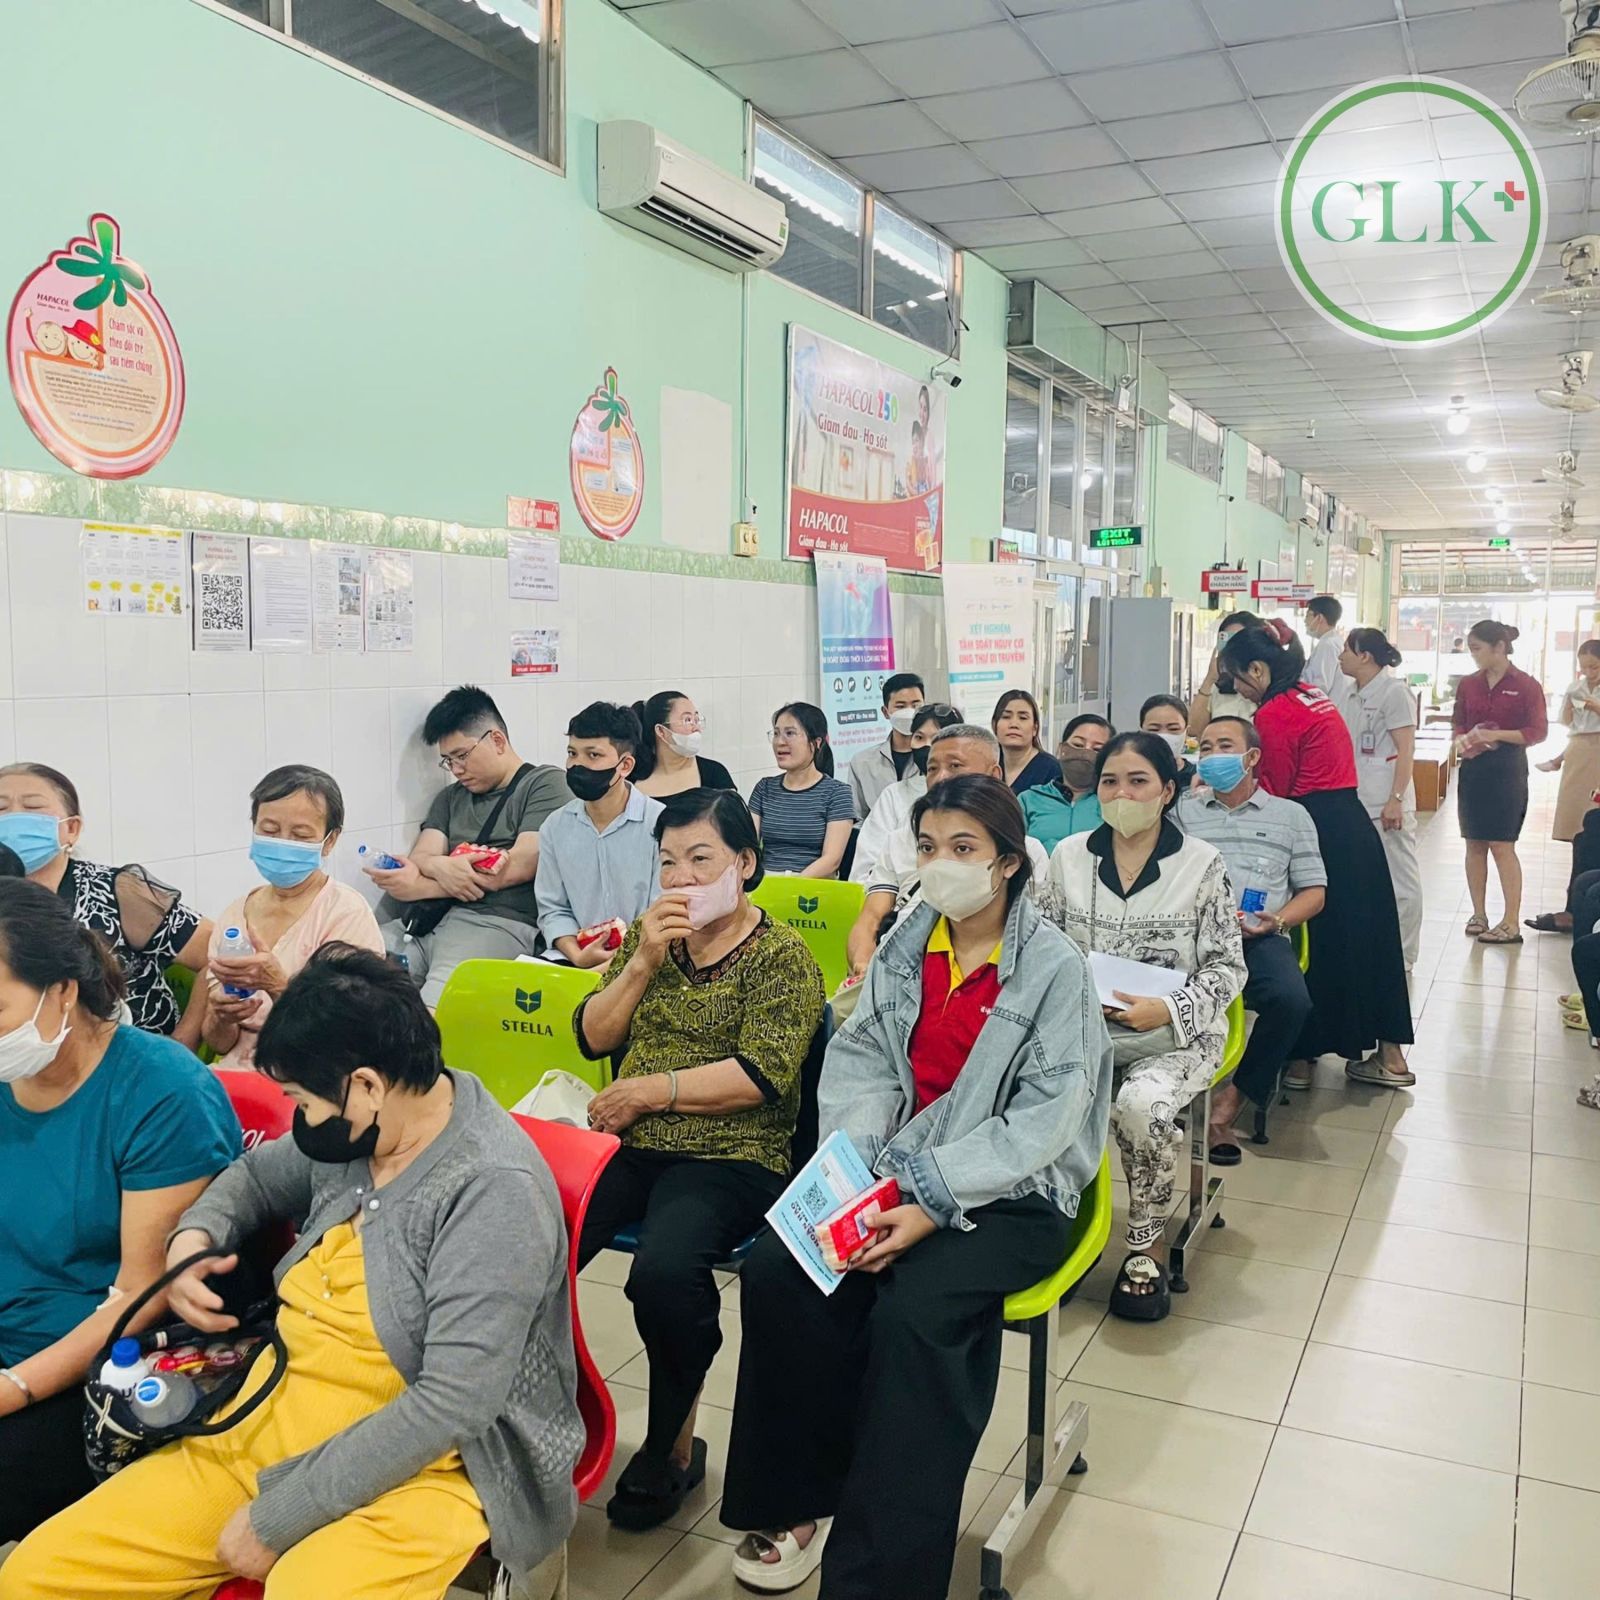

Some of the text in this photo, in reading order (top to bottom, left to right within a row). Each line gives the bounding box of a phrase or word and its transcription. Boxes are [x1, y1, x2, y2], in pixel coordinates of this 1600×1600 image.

[37, 293, 69, 306] HAPACOL
[818, 376, 898, 423] HAPACOL 250
[799, 507, 849, 535] HAPACOL
[1100, 528, 1131, 539] EXIT
[788, 918, 827, 930] STELLA
[502, 1019, 553, 1037] STELLA
[1131, 1257, 1152, 1269] LOVE
